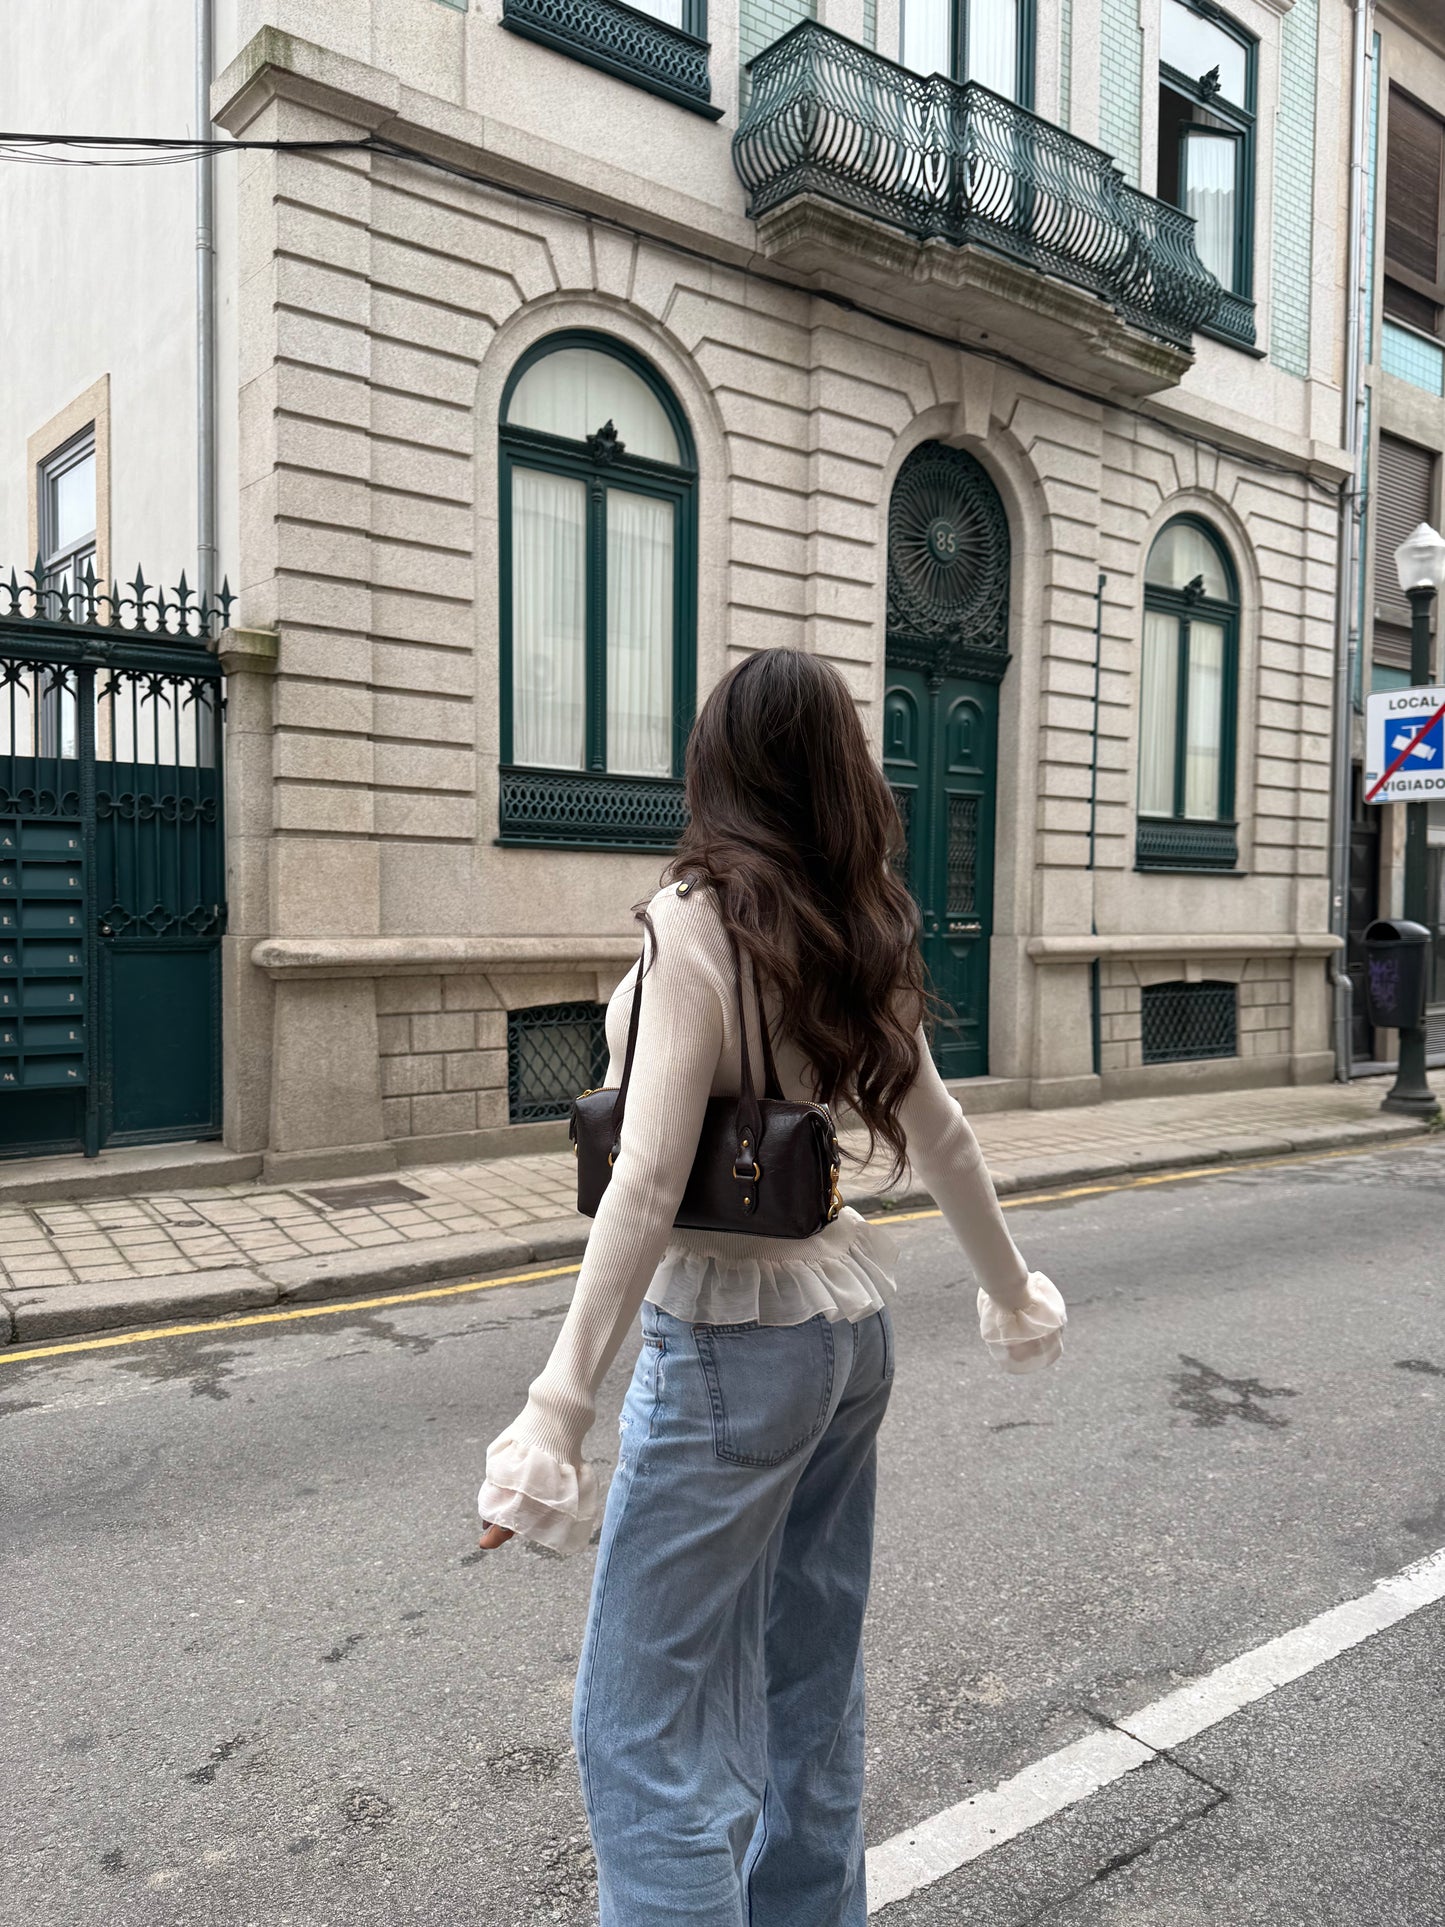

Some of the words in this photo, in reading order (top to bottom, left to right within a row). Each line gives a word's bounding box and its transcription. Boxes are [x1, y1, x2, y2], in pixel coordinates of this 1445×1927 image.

[937, 531, 955, 553] 85
[1388, 697, 1439, 711] LOCAL
[2, 837, 13, 847] A
[2, 876, 13, 886] C
[3, 916, 12, 926] E
[3, 954, 13, 964] G
[69, 954, 79, 964] H
[4, 1033, 14, 1043] K
[69, 1031, 78, 1040] L
[3, 1073, 15, 1081] M
